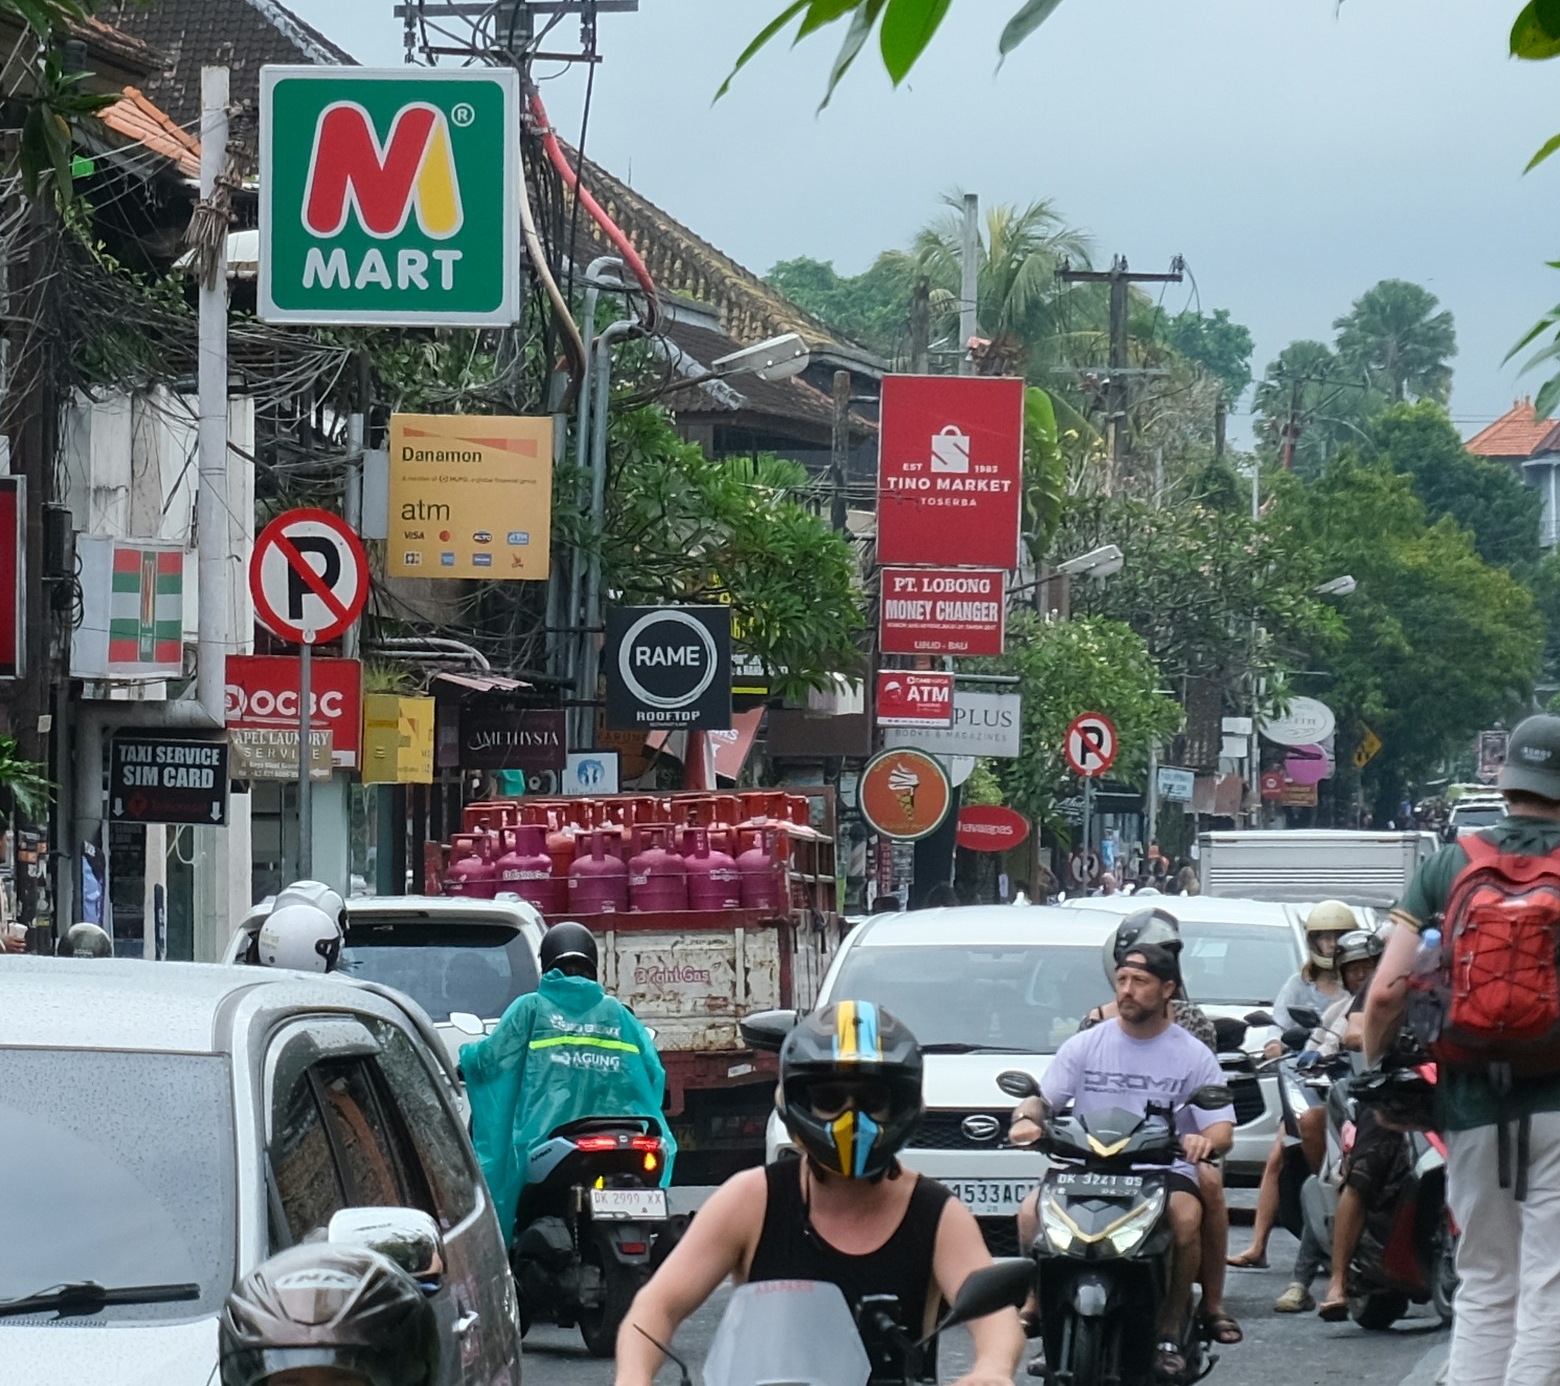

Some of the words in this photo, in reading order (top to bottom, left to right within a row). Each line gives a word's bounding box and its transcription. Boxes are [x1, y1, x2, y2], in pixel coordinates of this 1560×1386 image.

[302, 247, 463, 290] MART
[402, 446, 483, 463] Danamon
[902, 463, 923, 471] EST
[887, 477, 931, 490] TINO
[936, 477, 1012, 492] MARKET
[401, 499, 450, 521] atm
[921, 497, 977, 507] TOSERBA
[404, 530, 425, 541] VISA
[893, 577, 918, 593] PT.
[922, 578, 991, 594] LOBONG
[885, 599, 934, 621] MONEY
[936, 600, 999, 623] CHANGER
[635, 645, 701, 667] RAME
[906, 685, 949, 702] ATM
[636, 710, 701, 722] ROOFTOP
[954, 707, 1013, 728] PLUS
[268, 731, 330, 746] LAUNRY
[895, 729, 930, 737] BOOKS
[946, 731, 1008, 742] MAGAZINES
[119, 744, 153, 763] TAXI
[155, 745, 220, 766] SERVICE
[243, 747, 320, 760] SERVIE
[123, 766, 160, 786] SIM
[163, 768, 214, 789] CARD
[681, 965, 710, 984] Gas
[1057, 1173, 1077, 1184] DK
[594, 1192, 609, 1204] DK
[647, 1193, 662, 1204] XX
[952, 1183, 1034, 1203] 1533AC
